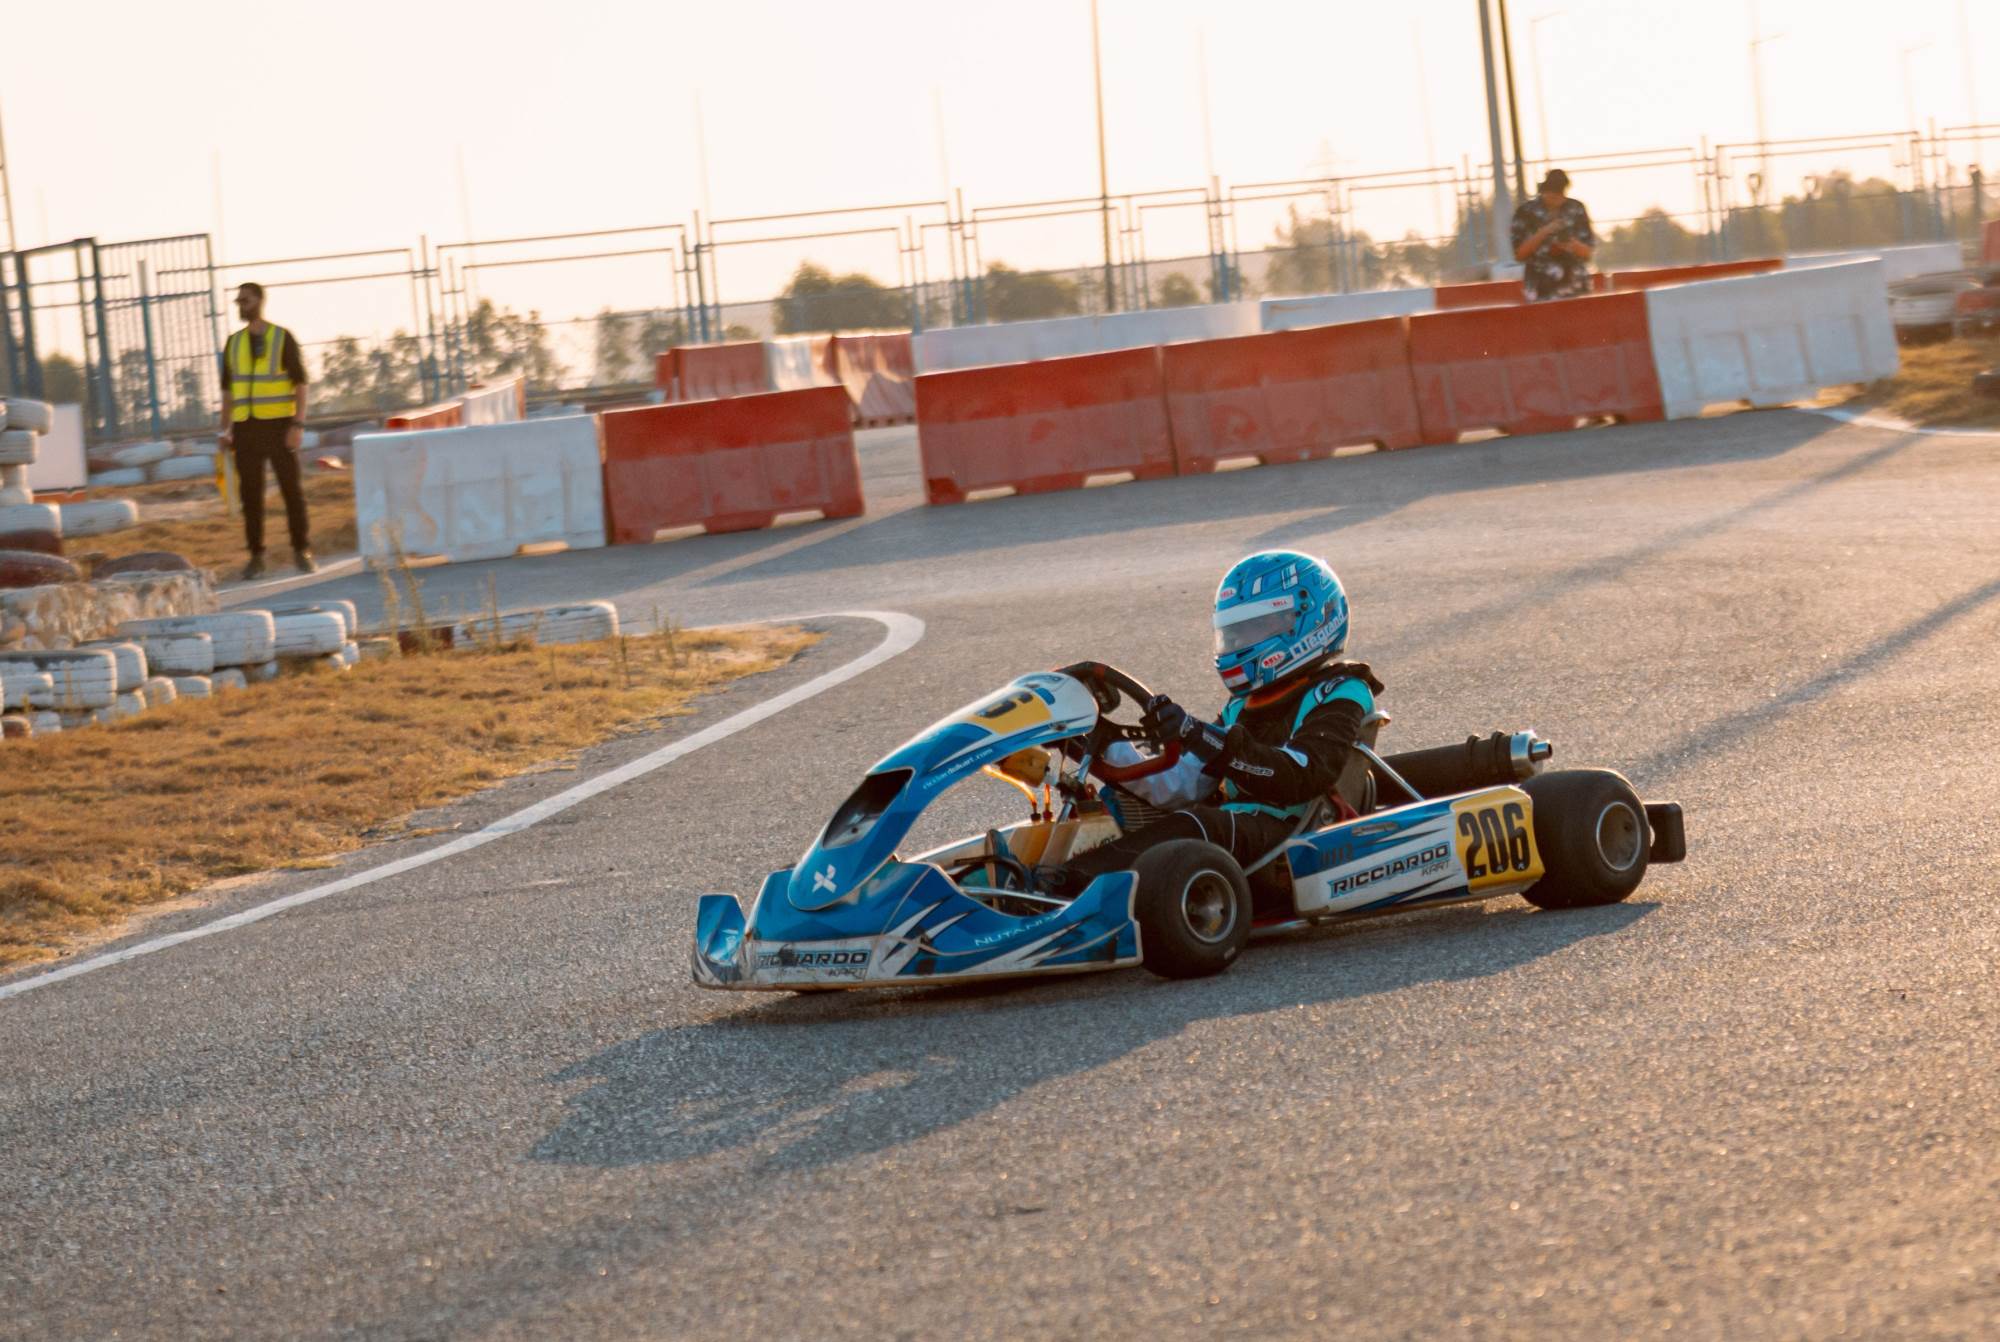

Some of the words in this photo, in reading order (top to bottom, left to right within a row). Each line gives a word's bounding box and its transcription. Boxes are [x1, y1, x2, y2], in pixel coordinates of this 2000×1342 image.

[1263, 653, 1283, 667] BELL
[1458, 802, 1531, 880] 206
[1333, 844, 1449, 895] RICCIARDO
[1422, 861, 1450, 876] KART
